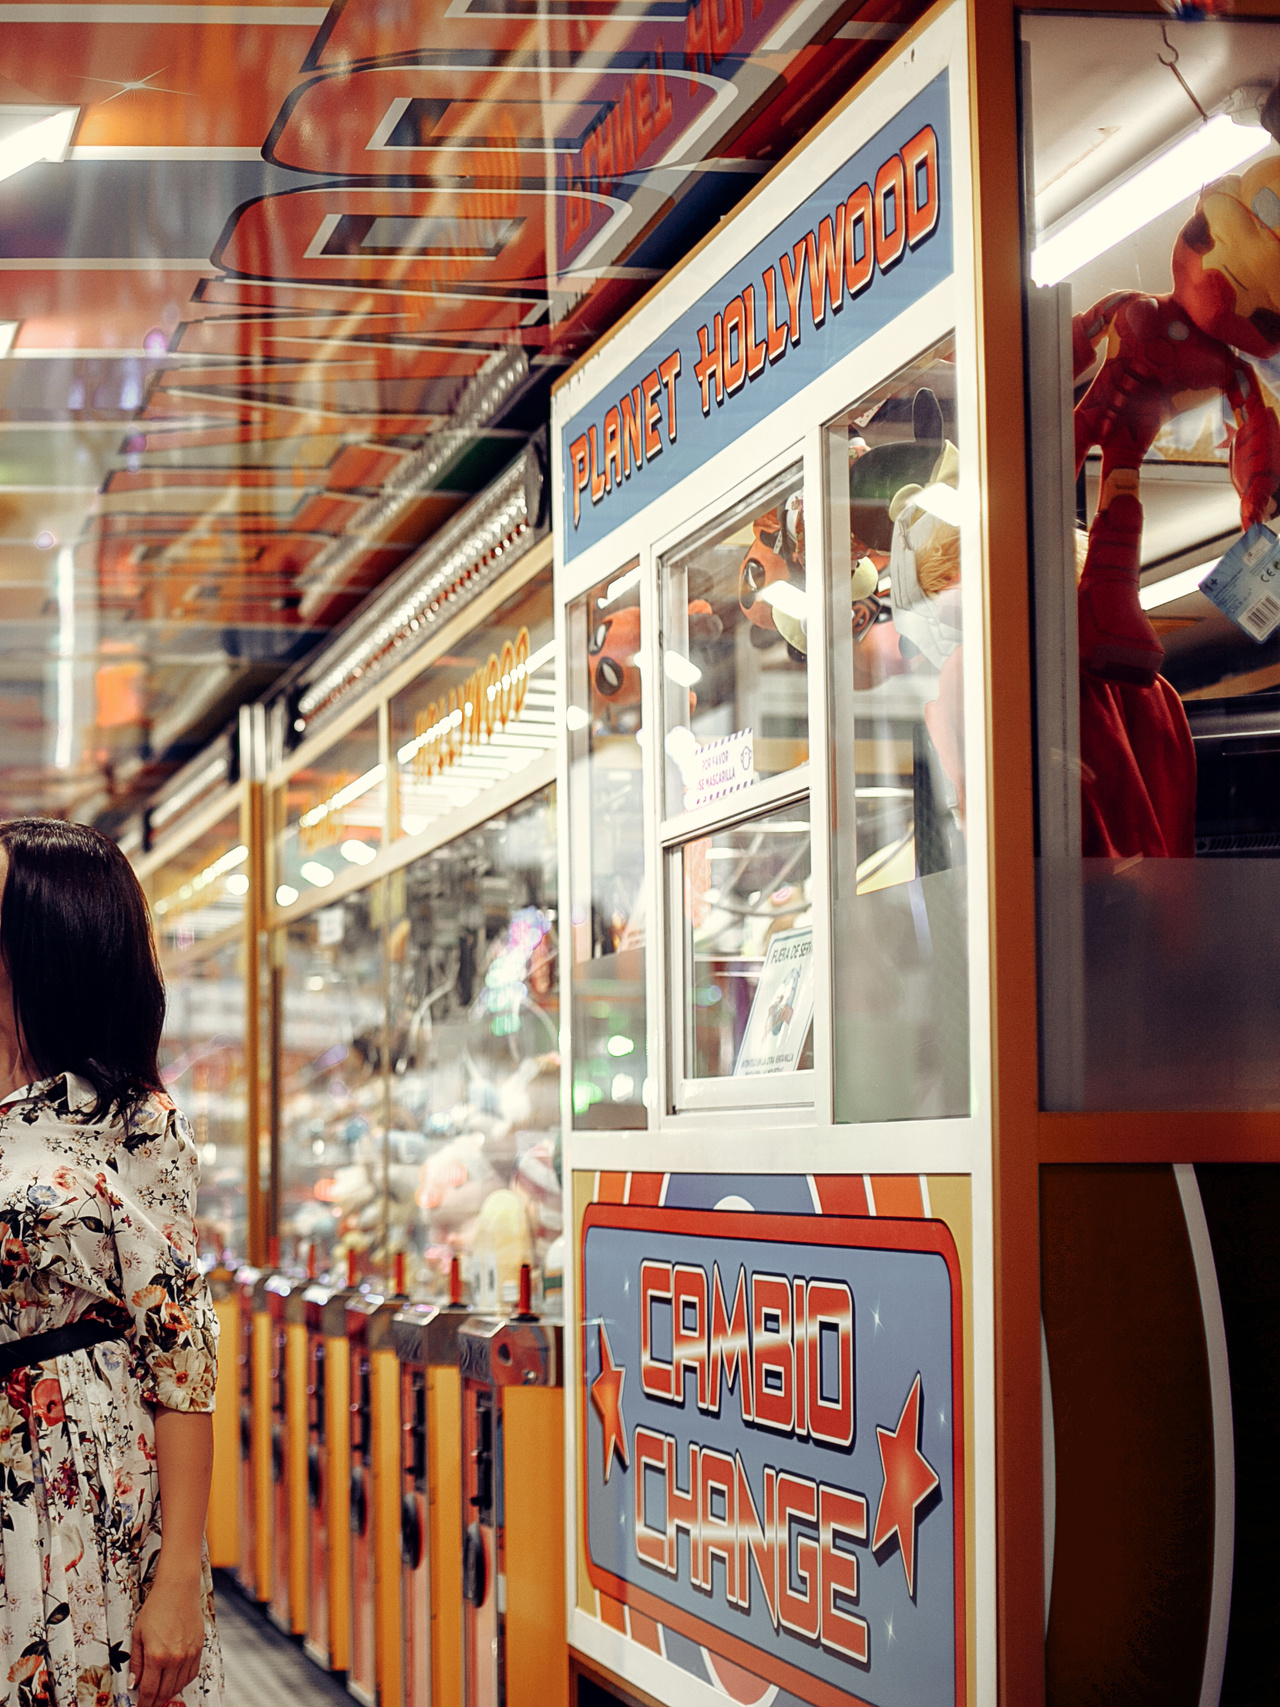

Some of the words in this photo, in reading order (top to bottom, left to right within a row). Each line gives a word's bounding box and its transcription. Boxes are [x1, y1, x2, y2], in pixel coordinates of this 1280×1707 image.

[570, 348, 682, 530] PLANET
[694, 123, 939, 418] HOLLYWOOD
[705, 766, 736, 787] MASCARILLA
[712, 750, 729, 766] FAVOR
[771, 946, 790, 964] FUERA
[790, 944, 801, 960] DE
[640, 1258, 856, 1450] CAMBIO
[634, 1424, 869, 1666] CHANGE
